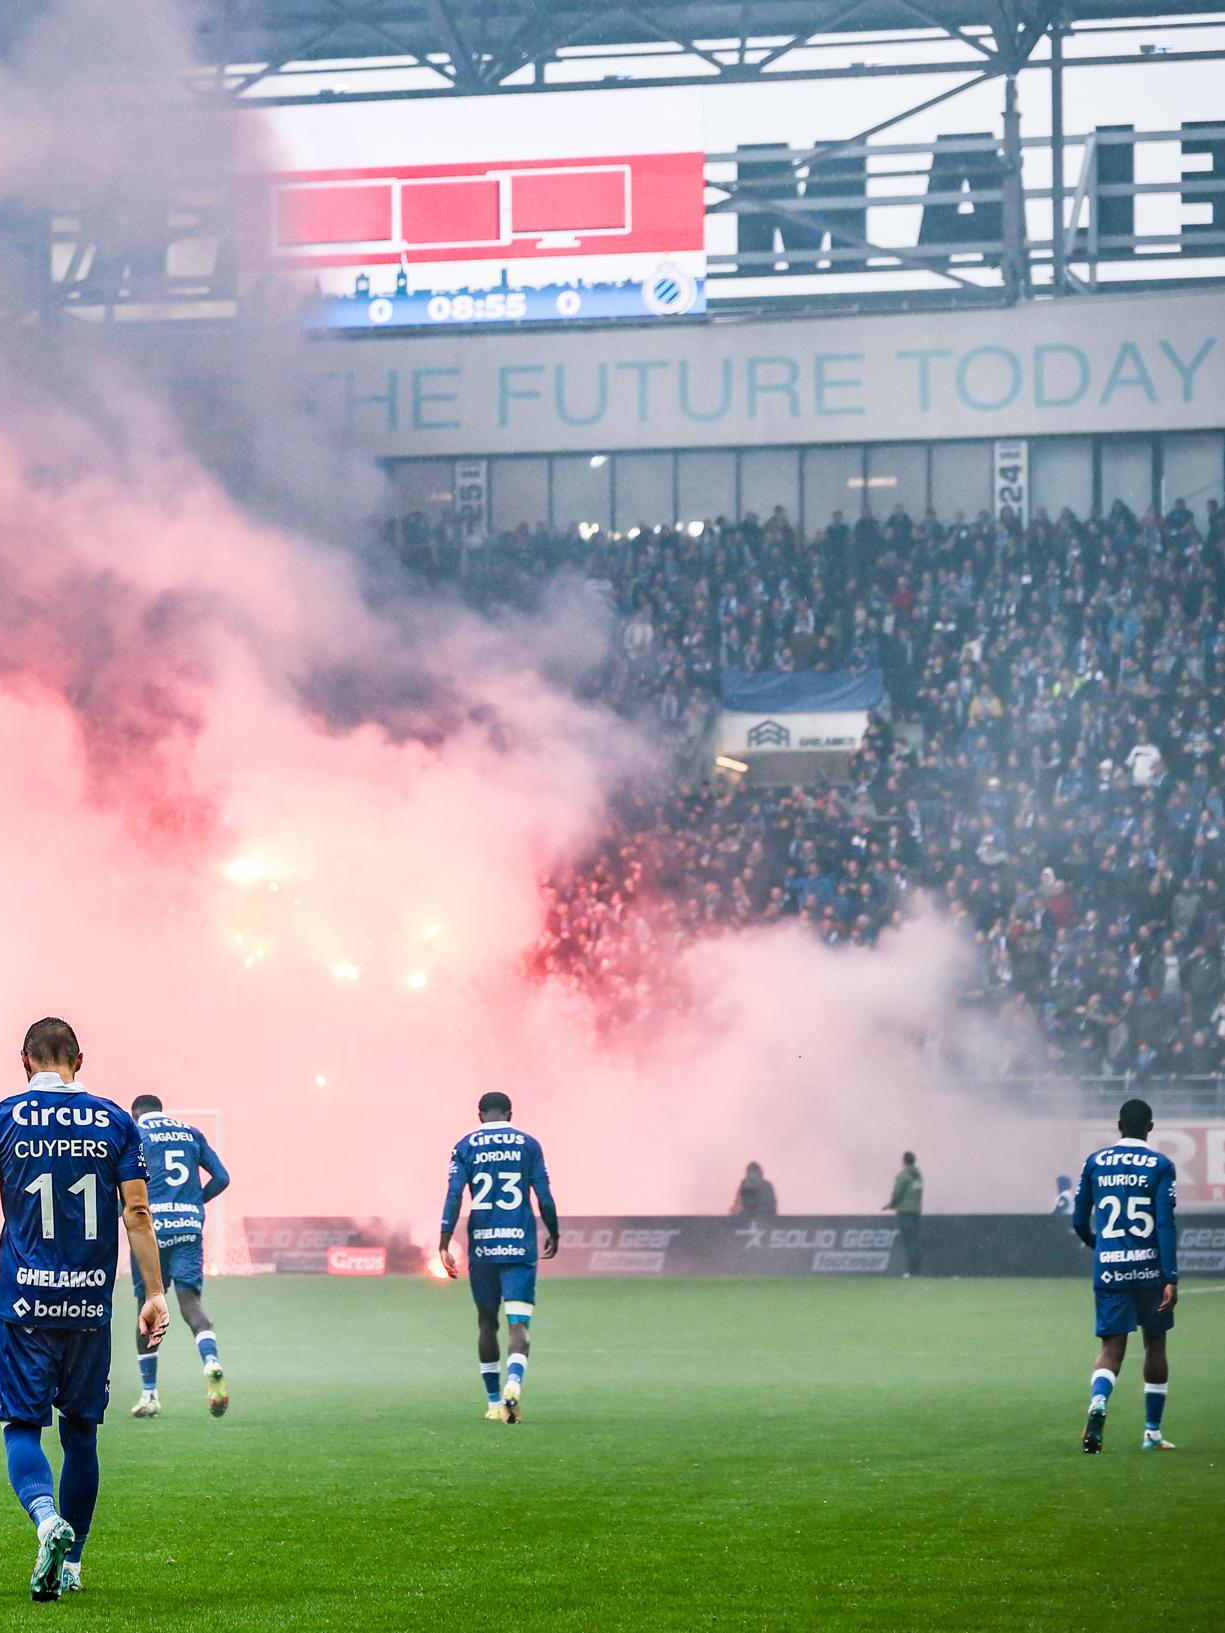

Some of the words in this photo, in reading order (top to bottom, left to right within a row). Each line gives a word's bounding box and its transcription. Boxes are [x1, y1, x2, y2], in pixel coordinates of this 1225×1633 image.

[369, 299, 393, 324] 0
[428, 292, 527, 322] 08:55
[556, 290, 581, 316] 0
[497, 352, 865, 430] FUTURE
[896, 338, 1217, 414] TODAY
[12, 1100, 110, 1128] Circus
[149, 1131, 193, 1143] NGADEU
[469, 1132, 525, 1147] Circus
[14, 1140, 108, 1159] CUYPERS
[473, 1151, 521, 1164] JORDAN
[1095, 1149, 1158, 1168] Circus
[164, 1150, 190, 1187] 5
[471, 1172, 523, 1211] 23
[24, 1173, 98, 1240] 11
[1098, 1195, 1154, 1239] 25
[484, 1244, 525, 1257] baloise
[16, 1267, 107, 1288] GHELAMCO
[1114, 1266, 1160, 1282] baloise
[34, 1299, 104, 1318] baloise
